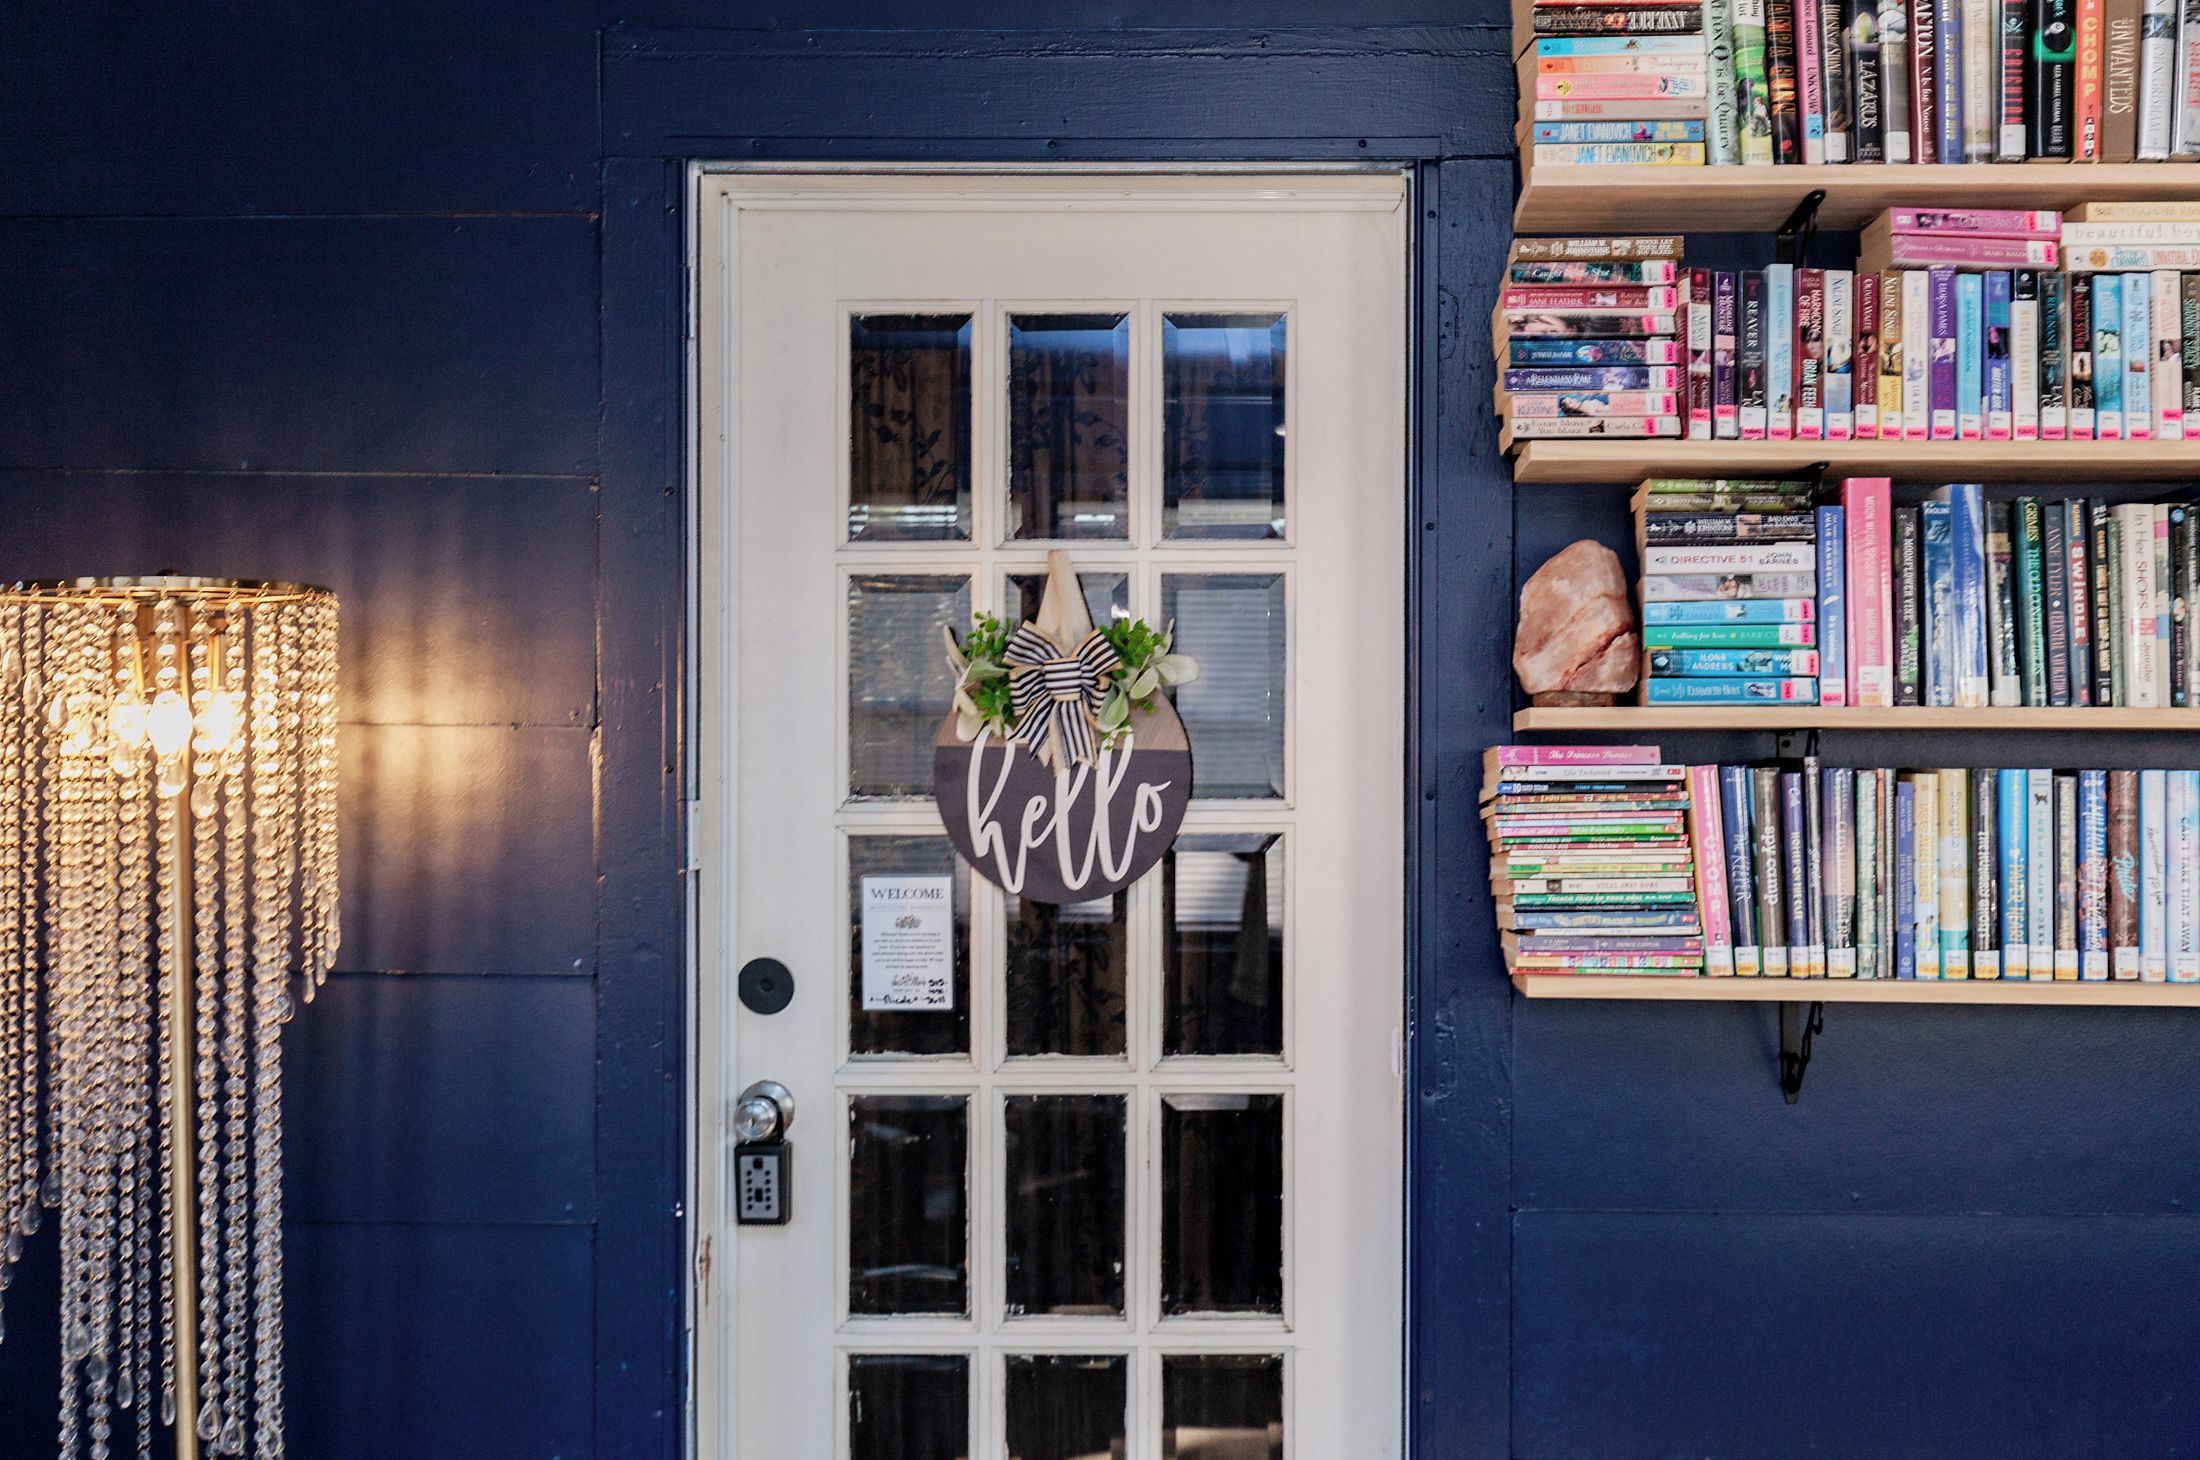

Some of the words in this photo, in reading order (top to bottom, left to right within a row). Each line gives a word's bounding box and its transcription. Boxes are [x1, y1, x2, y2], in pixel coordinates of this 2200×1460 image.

[1627, 11, 1655, 31] RICE
[1708, 44, 1731, 61] Q
[1805, 19, 1818, 56] Leonard
[2053, 64, 2063, 78] REED
[2082, 16, 2098, 97] CHOMP
[2109, 20, 2134, 113] UNWANTEDS
[2151, 44, 2167, 76] JOHN
[1717, 67, 1727, 78] is
[2003, 48, 2024, 124] CRICHTON
[1716, 82, 1729, 101] for
[1770, 65, 1796, 116] BURN
[1860, 58, 1879, 129] LAZARUS
[2053, 79, 2063, 97] FARREL
[1921, 104, 1933, 134] Noose
[2053, 98, 2063, 122] COLEMAN
[2150, 77, 2165, 132] GRISHAM
[1559, 124, 1589, 140] JANET
[1590, 122, 1632, 139] EVANOVICH
[1714, 102, 1731, 150] Quarry
[1575, 144, 1602, 163] JANET
[1605, 144, 1656, 162] EVANOVICH
[1568, 240, 1598, 248] WILLIAM
[2074, 224, 2162, 239] beautiful
[1566, 247, 1611, 256] JOHNSTONE
[1531, 268, 1563, 280] Caught
[1528, 298, 1551, 306] JANE
[1551, 298, 1584, 306] FEATHER
[1802, 295, 1811, 307] OF
[1832, 278, 1845, 307] NALINI
[1863, 278, 1874, 306] OLIVIA
[1884, 276, 1898, 308] NALINI
[2074, 290, 2086, 320] NALINI
[1718, 296, 1727, 332] HUNTER
[1726, 295, 1734, 333] MADELINE
[1746, 300, 1759, 349] REAVER
[1800, 308, 1811, 328] FIRE
[1810, 289, 1822, 332] HARMONY
[1832, 309, 1846, 336] SINGH
[1863, 306, 1874, 331] WAITE
[1884, 309, 1899, 340] SINGH
[2046, 296, 2058, 348] REVENANT
[2184, 298, 2197, 338] SHANNON
[1965, 333, 1973, 372] MORGAN
[2184, 339, 2197, 370] STACEY
[1803, 358, 1817, 384] BRIAN
[1864, 496, 1876, 520] MOON
[2025, 502, 2040, 542] GRIMES
[2134, 513, 2148, 527] In
[1698, 524, 1734, 532] JOHNSTONE
[1825, 511, 1833, 537] JULIE
[1864, 521, 1877, 546] WITCH
[1904, 521, 1915, 537] The
[2188, 516, 2196, 545] THROUGH
[1765, 551, 1794, 559] JOHN
[2047, 525, 2062, 558] ANNE
[2135, 530, 2149, 555] Her
[1670, 555, 1737, 565] DIRECTIVE
[1740, 554, 1754, 564] 51
[1759, 557, 1800, 566] BARNES
[1825, 540, 1833, 589] HAMMERLE
[1865, 547, 1877, 577] SPIDER
[1903, 538, 1914, 598] MOONFLOWER
[2028, 547, 2041, 569] THE
[1865, 578, 1877, 599] KING
[2028, 570, 2042, 592] OLD
[2048, 561, 2063, 598] TYLER
[2071, 546, 2086, 639] SWINDLE
[2135, 560, 2150, 609] SHOES
[1866, 608, 1878, 642] MARLON
[1903, 598, 1914, 622] VINE
[1671, 630, 1699, 640] Falling
[2030, 593, 2044, 677] CONTEMPTIBLES
[2050, 610, 2066, 650] CELESTIAL
[2175, 624, 2184, 657] Jennifer
[1827, 630, 1837, 663] raining
[1692, 660, 1735, 671] ANDREWS
[2051, 653, 2068, 696] NAVIGATION
[2143, 641, 2153, 683] Jennifer
[1548, 749, 1565, 760] The
[1565, 749, 1600, 761] Princess
[967, 724, 1171, 895] hello
[1919, 803, 1935, 831] YOU
[1761, 826, 1776, 856] spy
[1791, 832, 1802, 864] HOMER
[1977, 832, 1990, 853] THE
[2181, 816, 2192, 851] CAN'T
[1919, 834, 1935, 865] ARE
[1703, 835, 1723, 915] CHOMP
[1731, 853, 1752, 904] KEEPER
[1763, 858, 1779, 906] camp
[1792, 865, 1803, 880] ON
[2008, 863, 2025, 904] PAPER
[2111, 850, 2137, 903] Pride
[2181, 854, 2191, 884] TAKE
[871, 887, 944, 900] WELCOME
[1793, 882, 1803, 898] THE
[1919, 867, 1936, 904] HERE
[2181, 886, 2191, 916] THAT
[2005, 906, 2025, 943] HEART
[2181, 919, 2191, 953] AWAY
[2119, 966, 2136, 978] Teen
[2177, 968, 2195, 979] Teen
